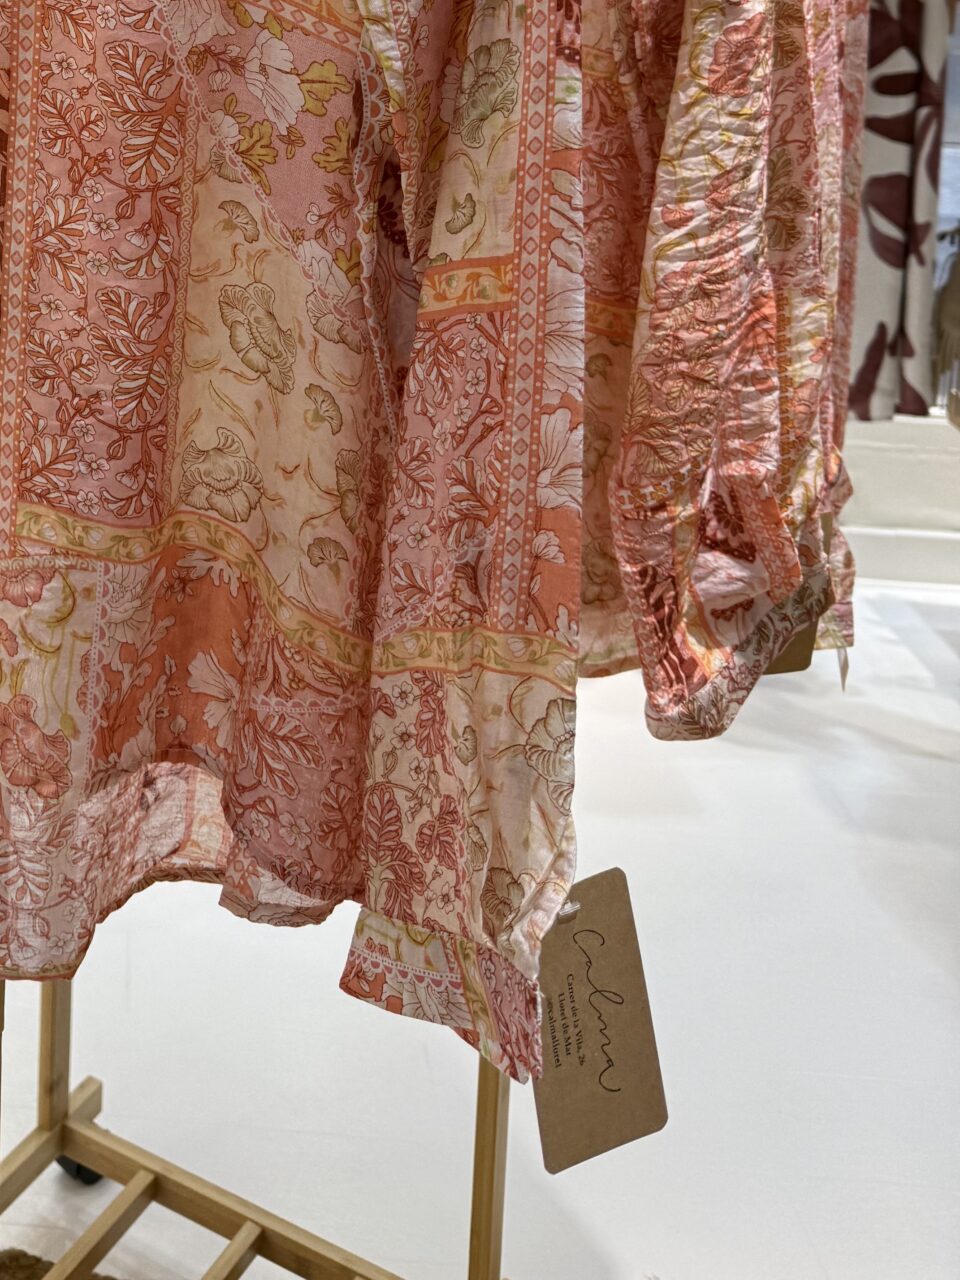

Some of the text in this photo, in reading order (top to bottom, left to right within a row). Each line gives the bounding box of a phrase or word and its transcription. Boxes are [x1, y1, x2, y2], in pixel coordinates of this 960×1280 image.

[567, 973, 576, 1003] Carrer
[571, 1006, 580, 1018] de
[558, 992, 572, 1056] Lloret de Mar
[573, 1019, 580, 1029] la
[578, 1053, 586, 1066] 26
